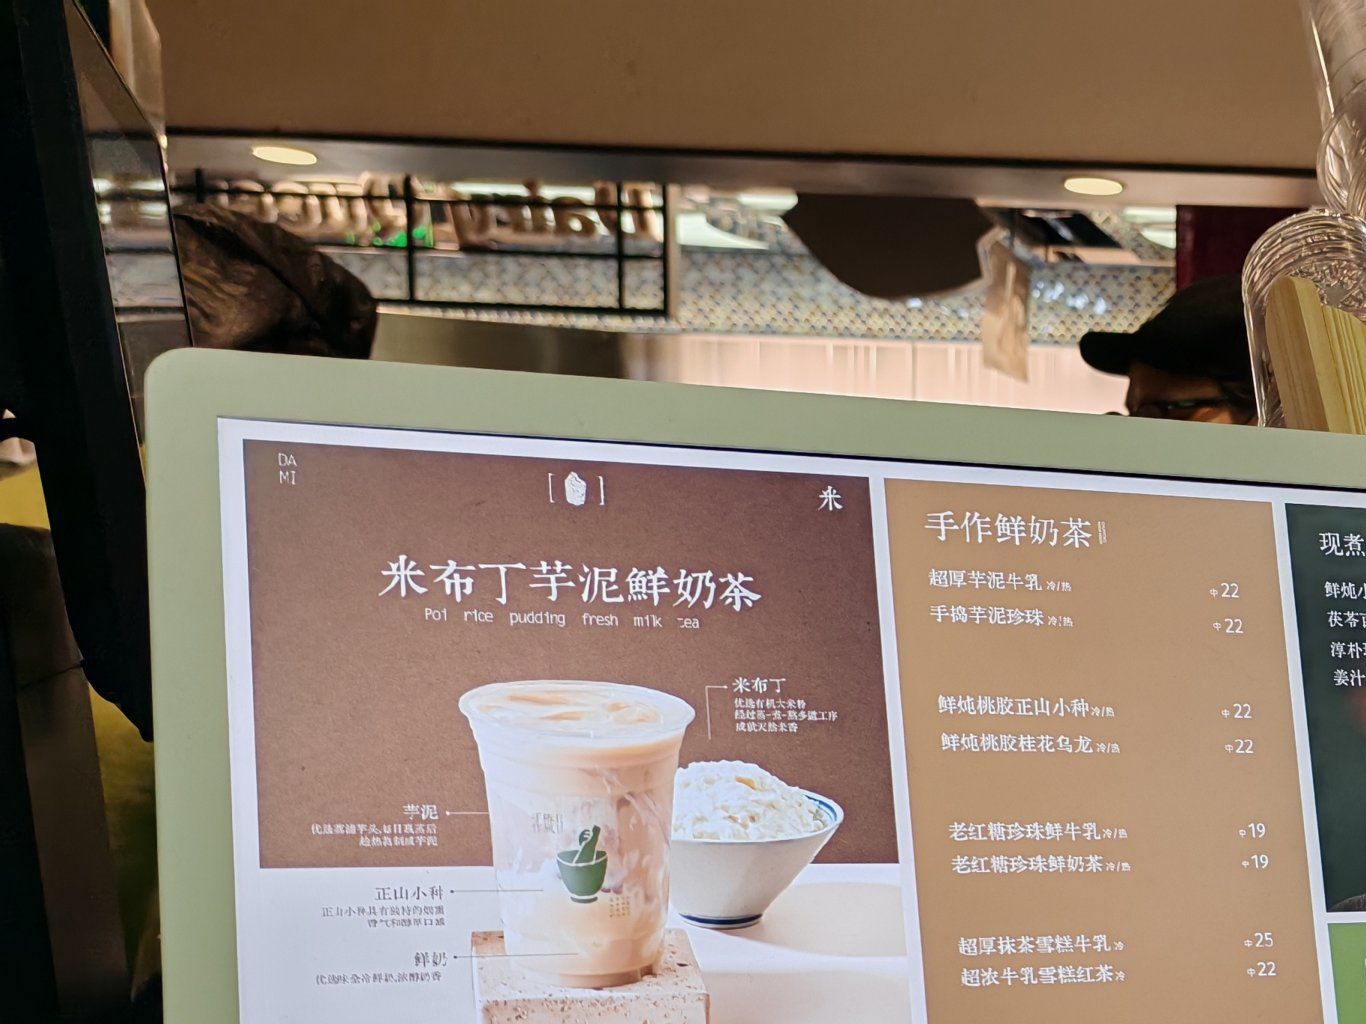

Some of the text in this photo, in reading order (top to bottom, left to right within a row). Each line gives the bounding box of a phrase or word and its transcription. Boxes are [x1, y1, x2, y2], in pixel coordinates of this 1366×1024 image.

[278, 453, 297, 466] DA
[280, 470, 296, 485] MI
[924, 510, 1092, 548] 手作鲜奶茶
[928, 568, 1042, 592] 超厚芋泥牛乳
[464, 610, 494, 622] rice
[509, 611, 566, 627] pudding
[583, 613, 618, 626] fresh
[633, 614, 662, 627] milk
[930, 605, 1044, 627] 手捣芋泥珍珠
[732, 677, 786, 693] 米布丁
[938, 694, 1090, 718] 鲜炖桃胶正山小种
[941, 733, 1093, 754] 鲜炖桃胶桂花乌龙
[402, 804, 439, 820] 芋泥
[949, 822, 1101, 842] 老红糖珍珠鲜牛乳
[951, 854, 1104, 874] 老红糖珍珠鲜奶茶
[958, 934, 1111, 956] 超厚抹茶雪糕牛乳
[961, 964, 1114, 987] 超浓牛乳雪糕红茶
